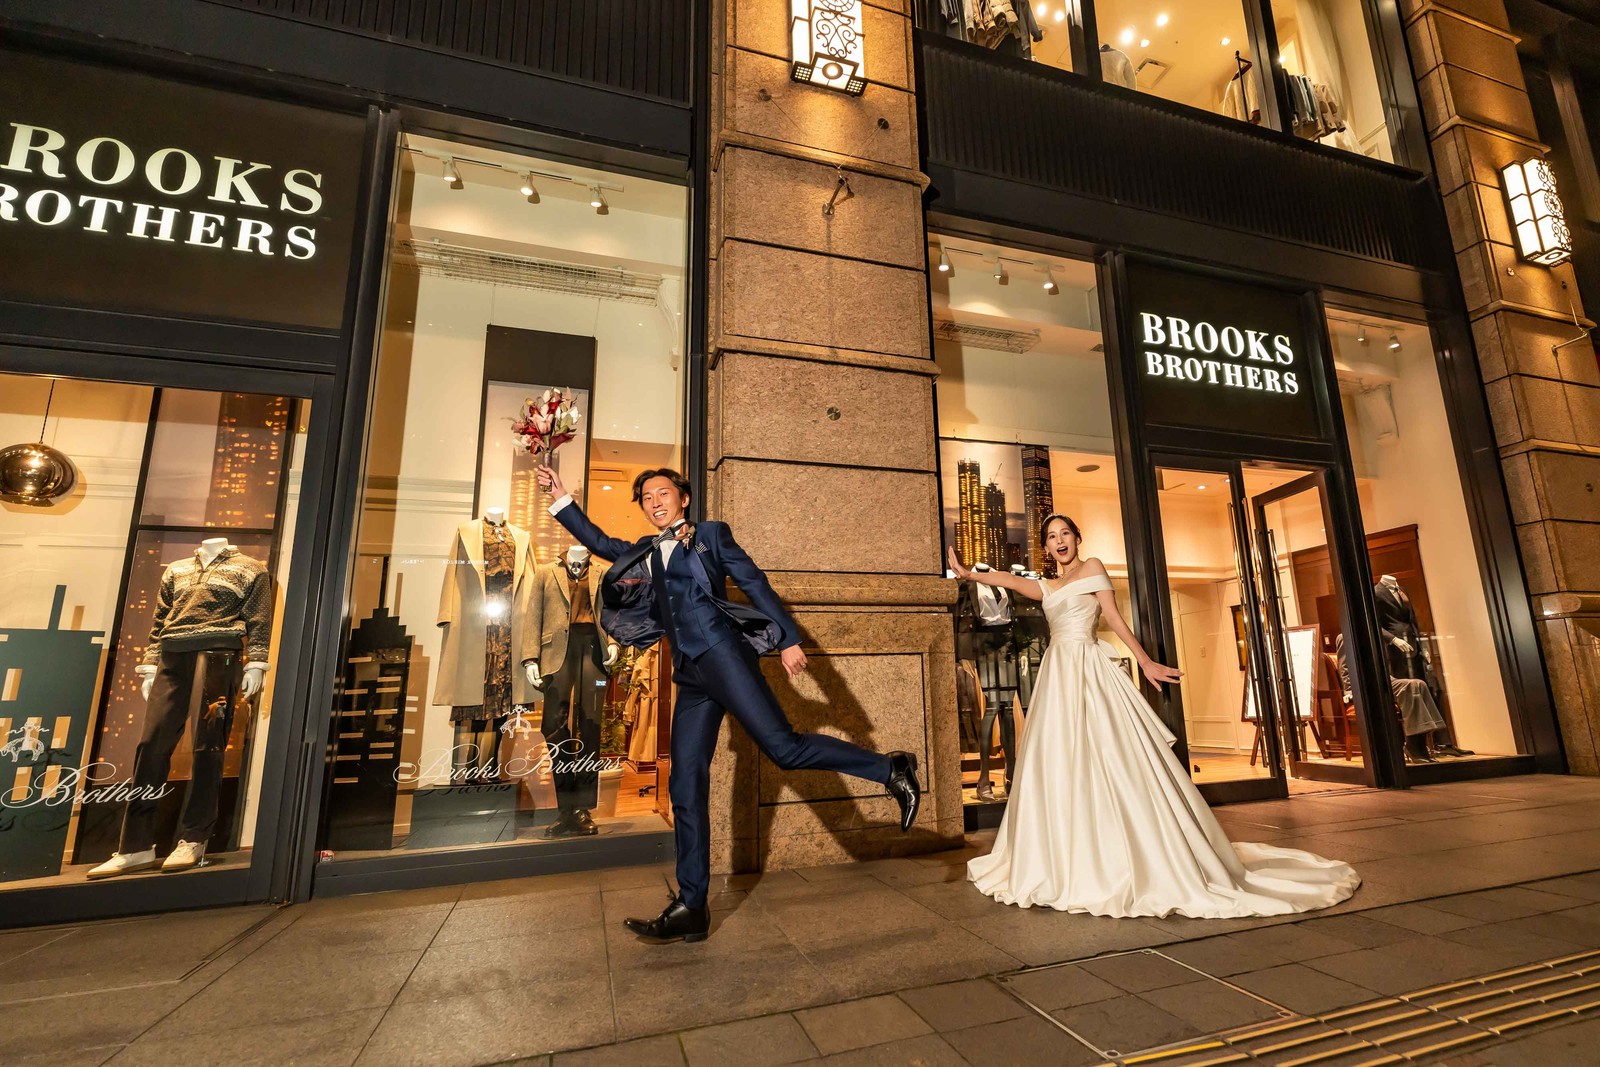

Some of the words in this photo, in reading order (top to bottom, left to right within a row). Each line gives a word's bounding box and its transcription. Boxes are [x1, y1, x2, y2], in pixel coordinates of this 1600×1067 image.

[0, 122, 323, 215] ROOKS
[1140, 312, 1295, 365] BROOKS
[1144, 351, 1299, 395] BROTHERS
[0, 761, 175, 808] Brothers
[393, 743, 502, 784] Brooks
[505, 738, 624, 777] Brothers
